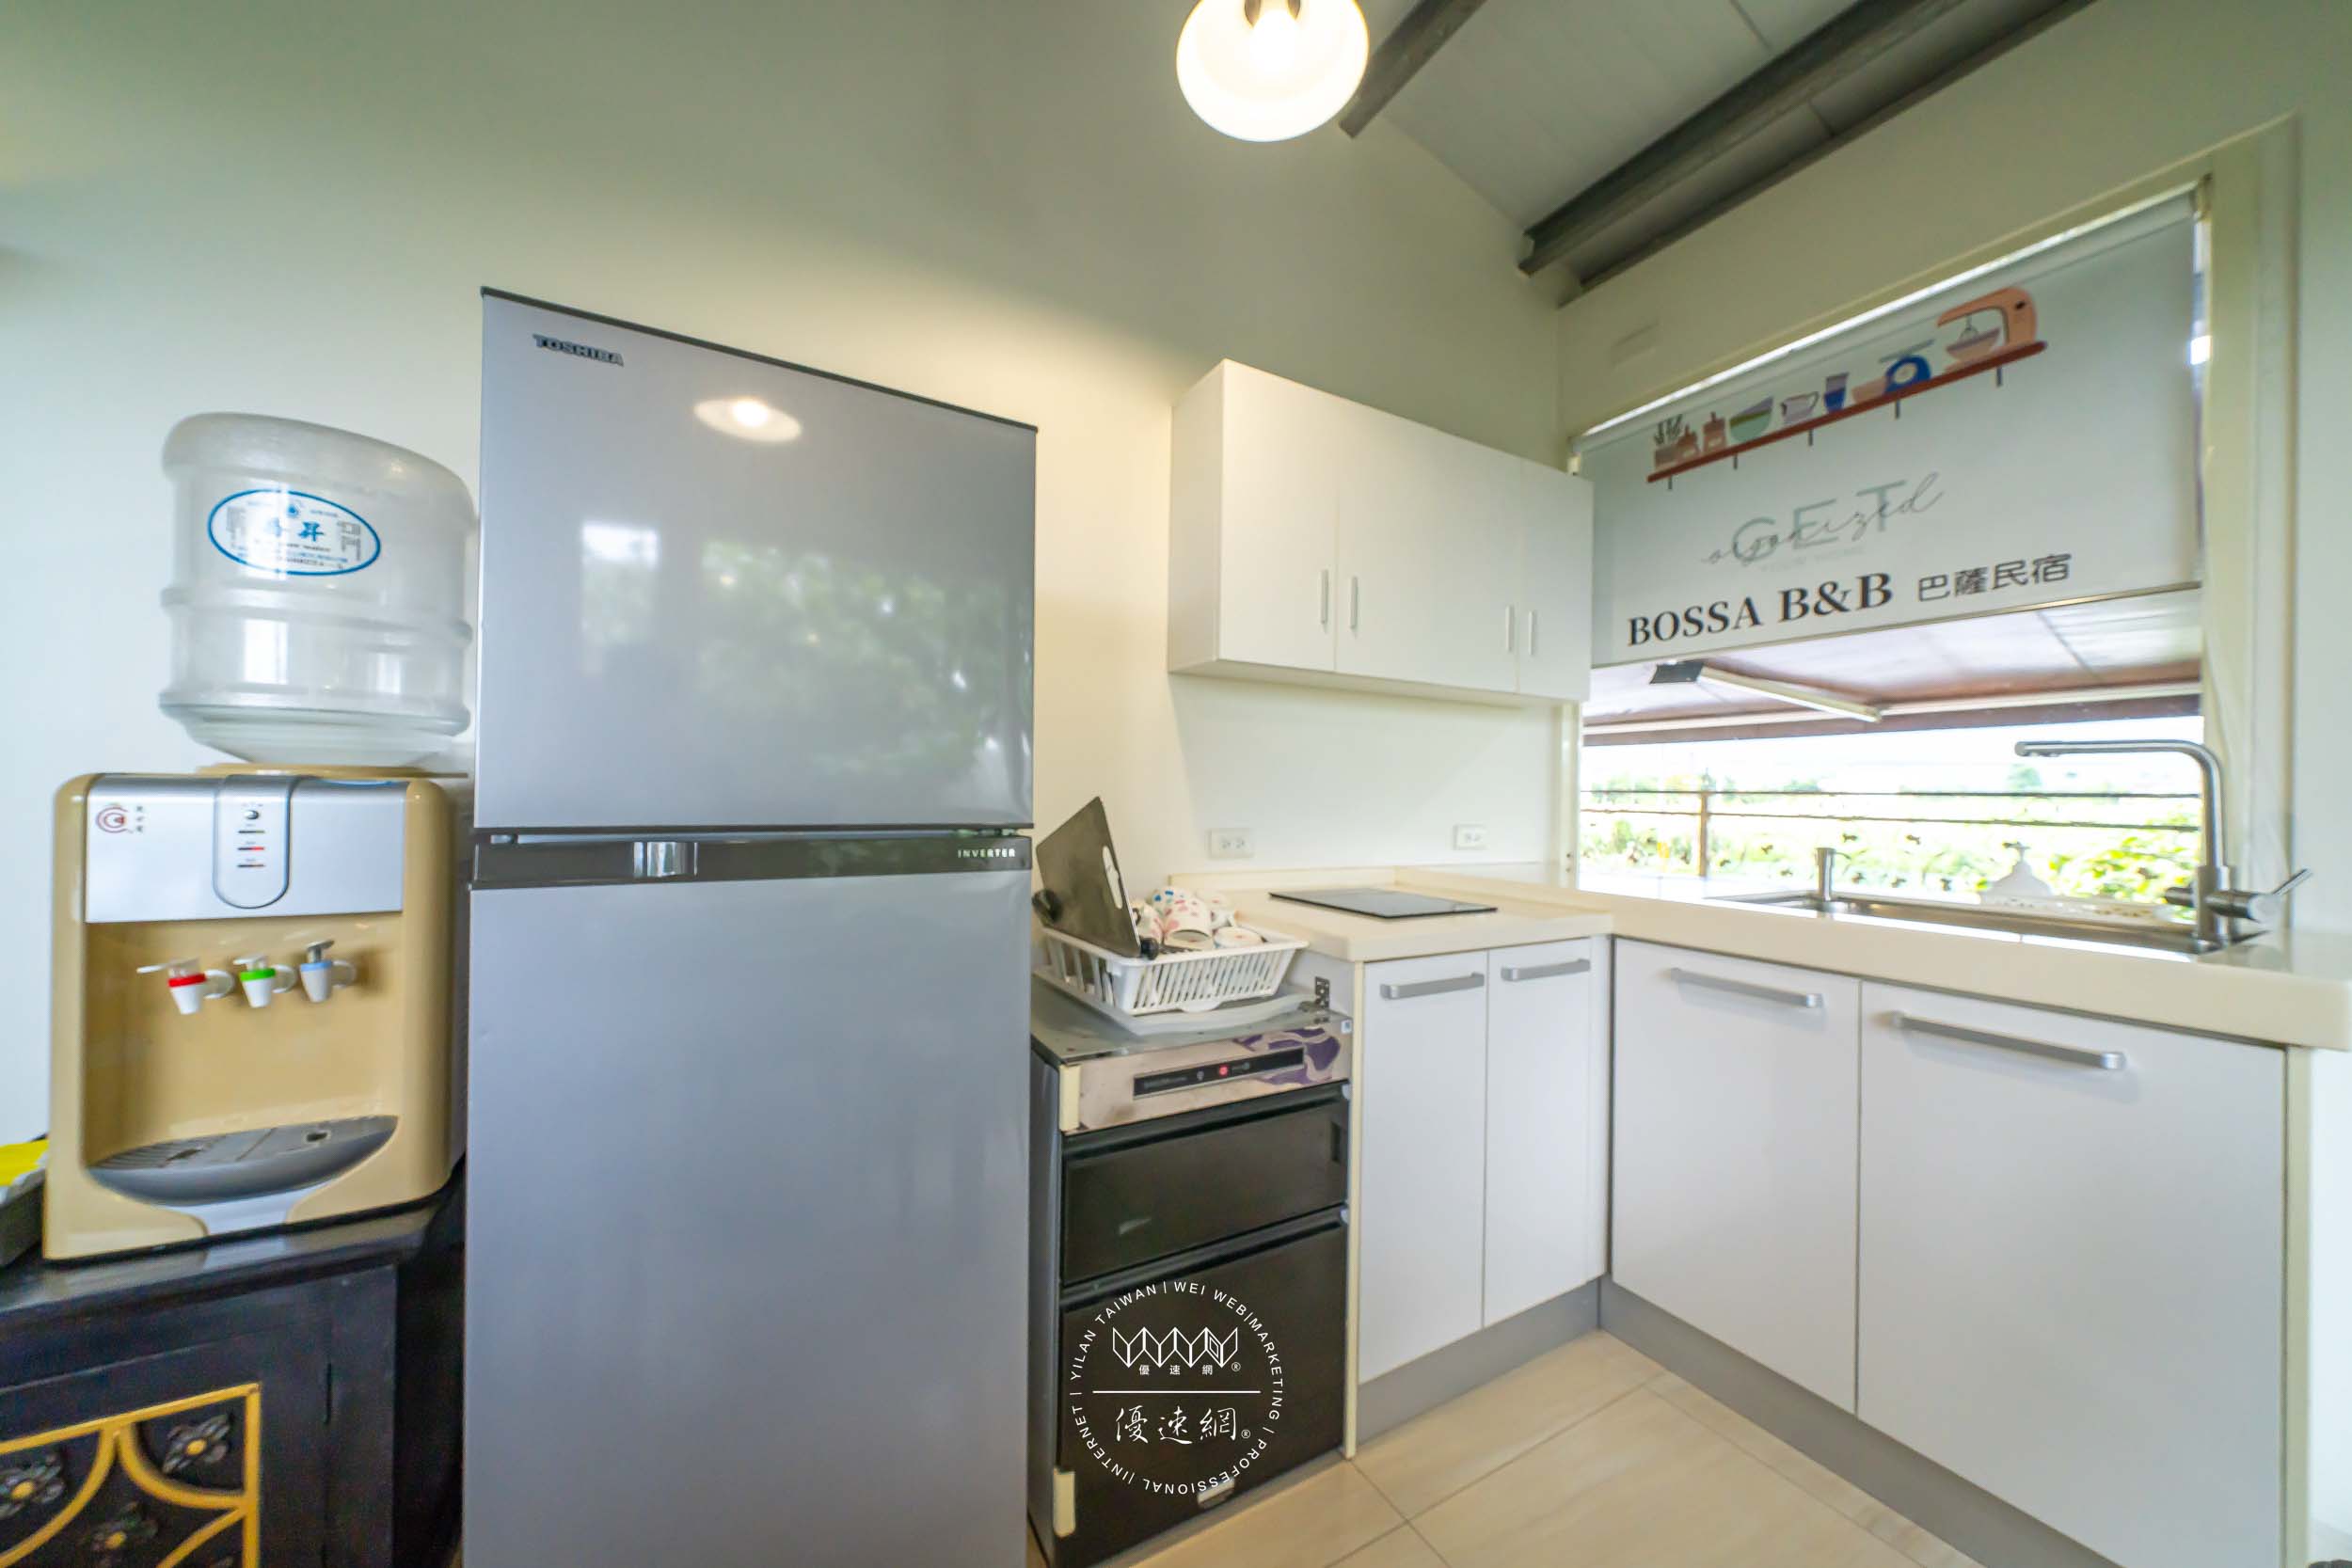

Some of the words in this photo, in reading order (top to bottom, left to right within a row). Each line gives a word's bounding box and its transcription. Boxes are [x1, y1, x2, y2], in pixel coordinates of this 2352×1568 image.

[532, 334, 624, 367] TOSHIBA
[1628, 596, 1762, 646] BOSSA
[1777, 572, 1894, 623] B&B
[958, 848, 1015, 859] INVERTER
